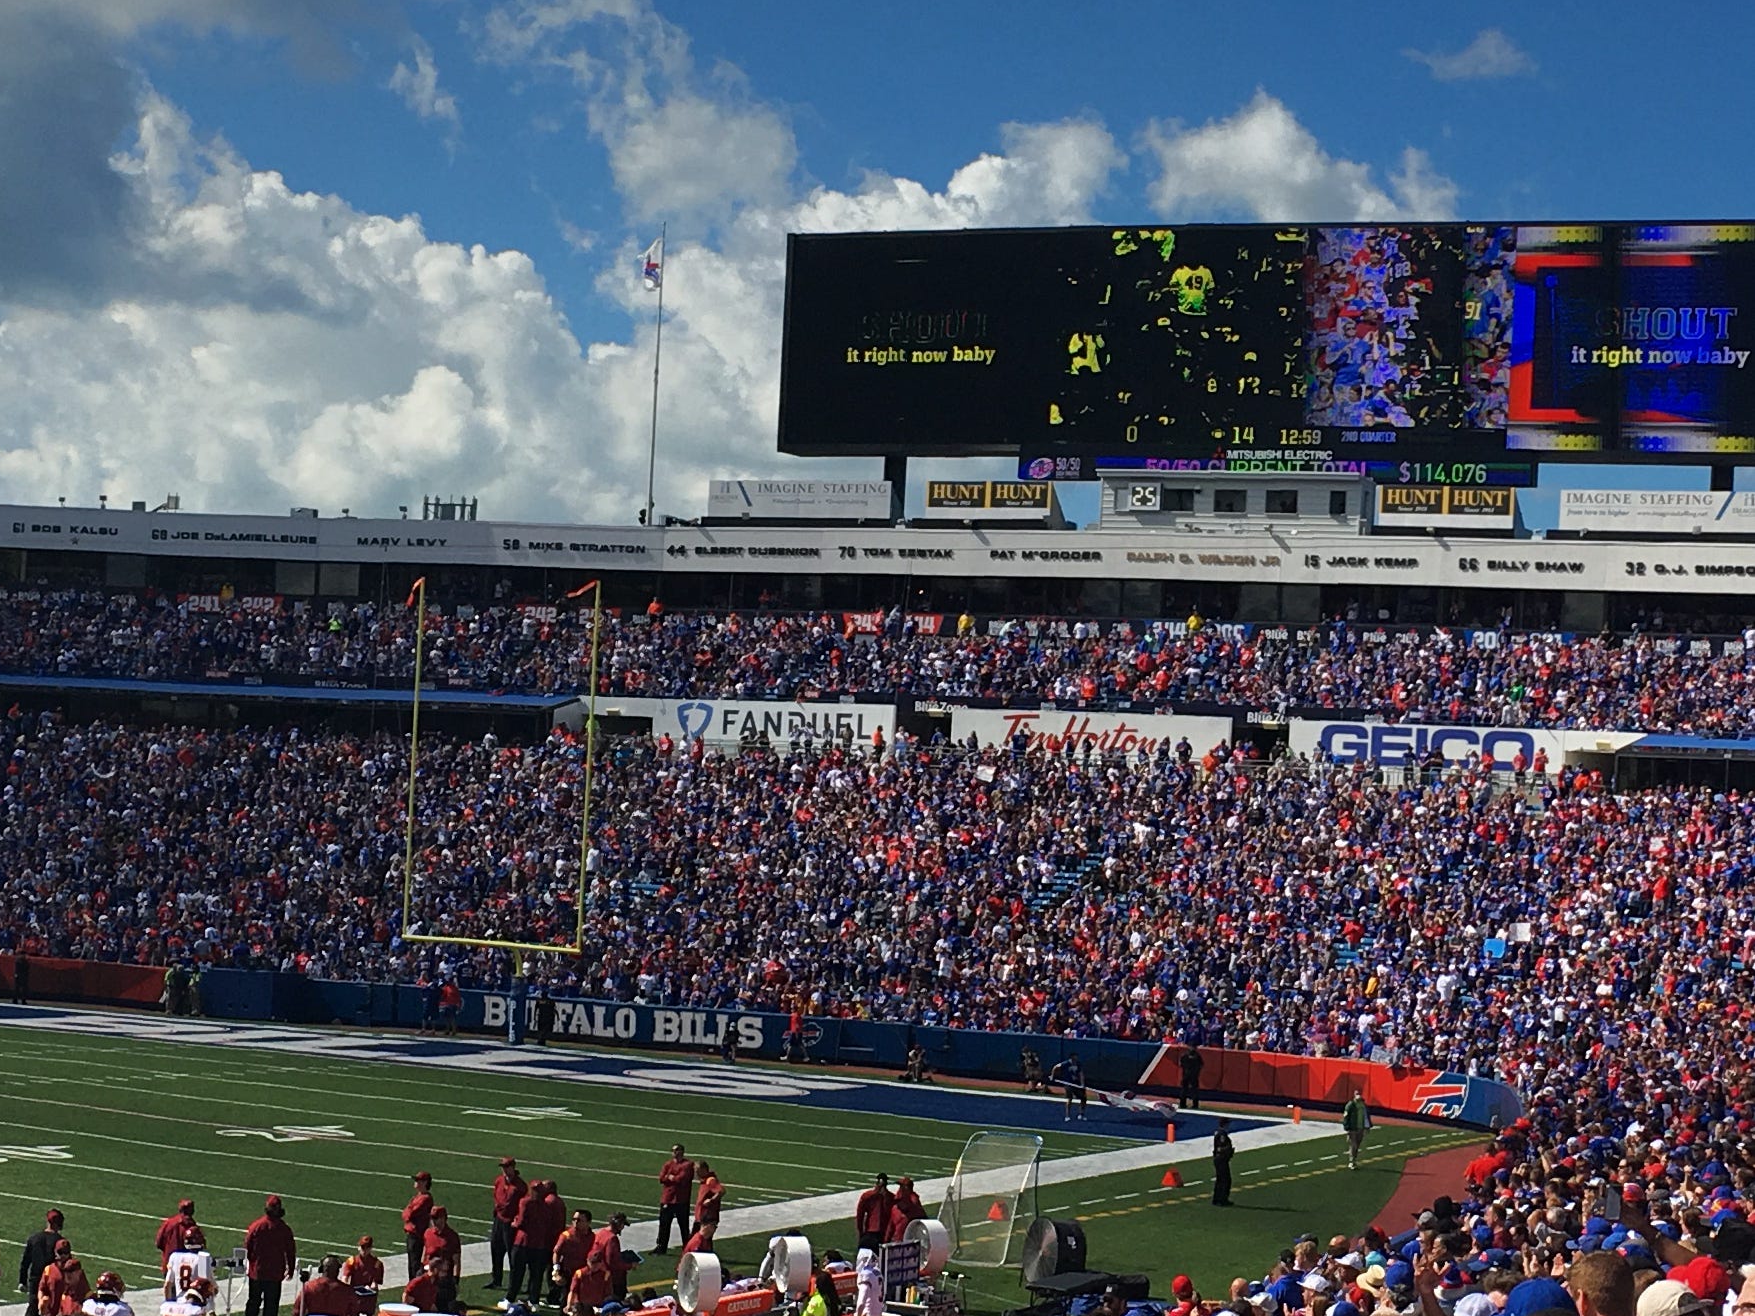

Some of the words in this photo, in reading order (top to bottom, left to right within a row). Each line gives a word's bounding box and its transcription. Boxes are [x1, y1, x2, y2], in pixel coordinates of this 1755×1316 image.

[1186, 274, 1203, 290] 49
[847, 347, 860, 363] it
[864, 347, 905, 366] right
[912, 348, 948, 363] now
[953, 346, 996, 366] baby
[1572, 346, 1586, 364] it
[1591, 346, 1643, 367] right
[1647, 348, 1691, 364] now
[1696, 345, 1750, 368] baby
[1126, 425, 1138, 444] 0
[1232, 426, 1255, 444] 14
[1279, 429, 1322, 445] 12:59
[1227, 449, 1283, 460] MITSUBISHI
[1284, 449, 1333, 460] ELECTRIC
[1056, 457, 1081, 471] 50/50
[758, 483, 815, 494] IMAGINE
[823, 483, 887, 494] STAFFING
[933, 484, 984, 500] HUNT
[995, 484, 1046, 500] HUNT
[1132, 487, 1156, 505] 25
[1386, 488, 1440, 505] HUNT
[1453, 489, 1508, 506] HUNT
[1566, 492, 1632, 505] IMAGINE
[1639, 493, 1713, 506] STAFFING
[31, 524, 62, 534] BOB
[171, 531, 199, 542] JOE
[357, 537, 400, 547] MARV
[407, 537, 448, 548] LEVY
[529, 541, 563, 552] MIKE
[666, 545, 687, 558] 44
[863, 548, 892, 558] TOM
[990, 550, 1016, 561] PAT
[1126, 552, 1175, 564] RALPH
[1260, 555, 1281, 567] JR
[1304, 554, 1320, 569] 15
[1326, 556, 1368, 568] JACK
[1374, 557, 1419, 569] KEMP
[1487, 560, 1530, 572] BILLY
[1535, 561, 1585, 573] SHAW
[1625, 561, 1646, 575] 32
[188, 596, 220, 613] 241
[723, 710, 871, 740] FANDUEL
[1320, 723, 1535, 770] GEICO
[484, 994, 637, 1041] BFALO
[652, 1010, 764, 1049] BILLS
[179, 1266, 193, 1293] 8
[726, 1297, 762, 1312] GATORADE
